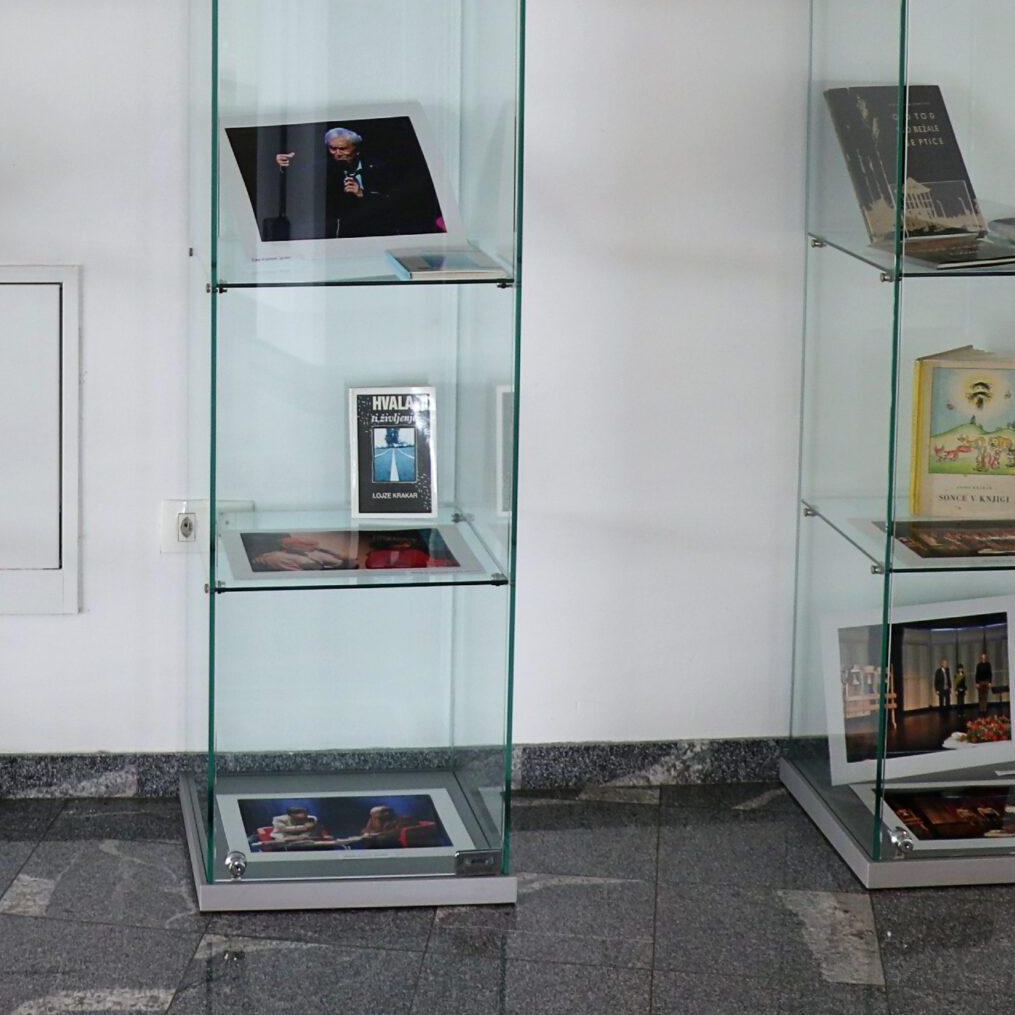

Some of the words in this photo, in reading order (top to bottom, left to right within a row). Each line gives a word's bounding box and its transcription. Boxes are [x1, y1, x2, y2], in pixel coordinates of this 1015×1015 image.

[372, 395, 414, 411] HVALA
[372, 491, 392, 499] LOJZE
[392, 491, 418, 499] KRAKAR
[936, 494, 967, 503] SONCE
[968, 494, 975, 502] V
[979, 495, 1010, 504] KNJIGI
